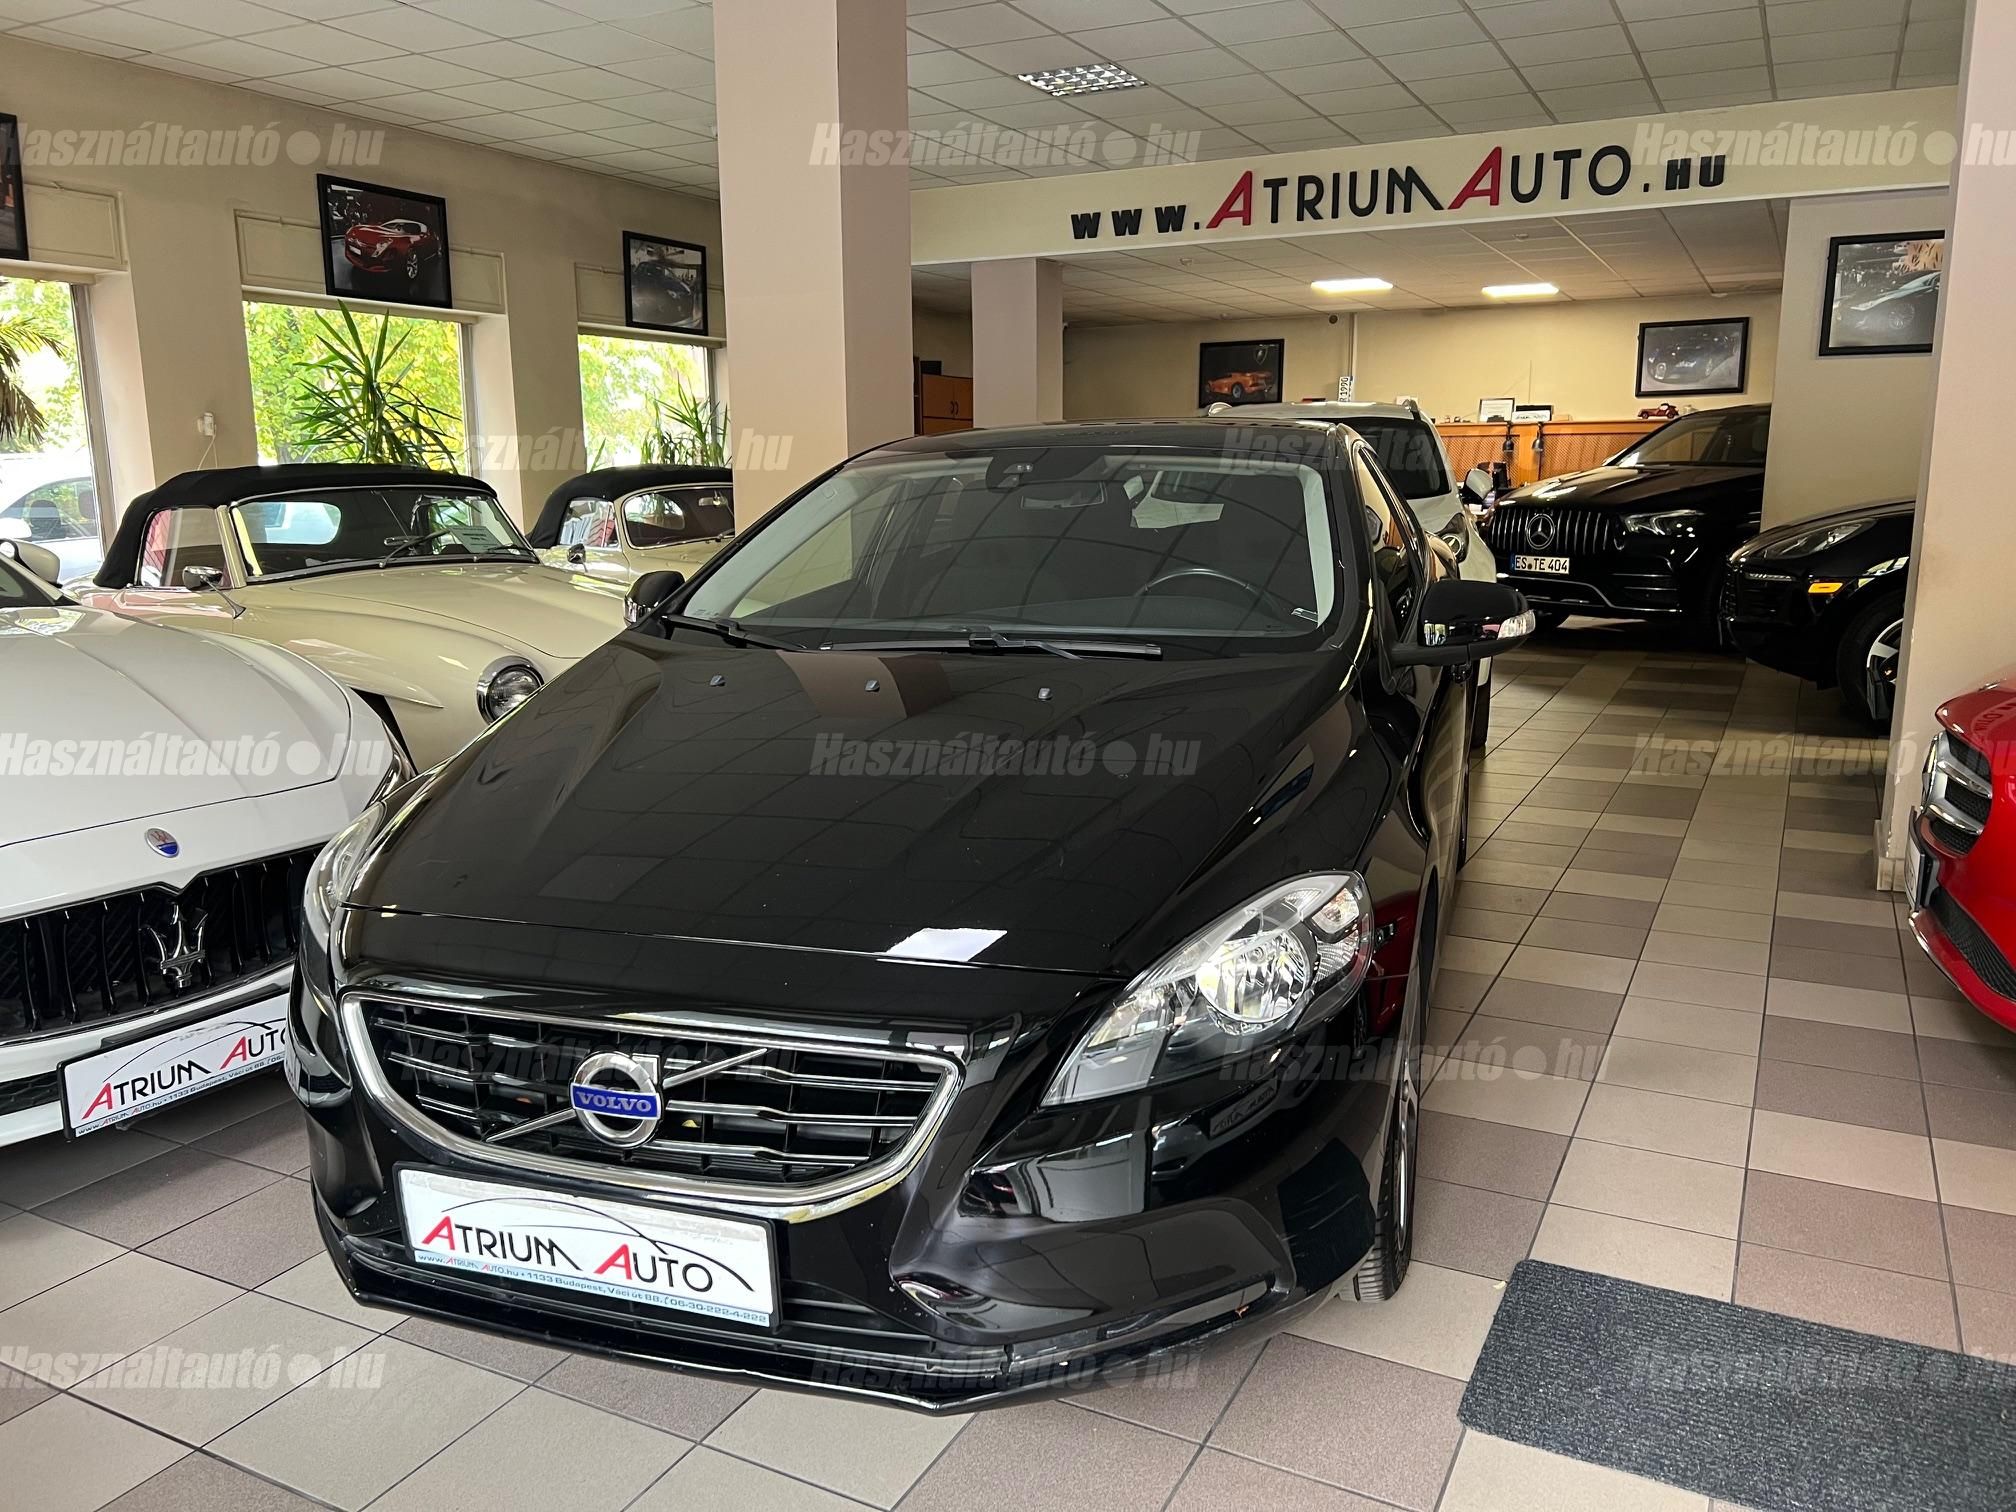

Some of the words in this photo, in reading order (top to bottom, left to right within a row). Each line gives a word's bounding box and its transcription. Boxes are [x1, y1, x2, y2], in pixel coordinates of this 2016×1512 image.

[1515, 556, 1527, 569] ES
[1534, 558, 1546, 571] TE
[1548, 558, 1568, 572] 404
[81, 1060, 212, 1119] ATRIUM
[220, 1027, 285, 1070] AUT
[576, 1091, 652, 1112] VOLVO
[422, 1215, 583, 1272] ATRIUM
[594, 1243, 713, 1293] AUTO
[527, 1271, 553, 1283] 1133
[555, 1278, 606, 1294] Budapest,
